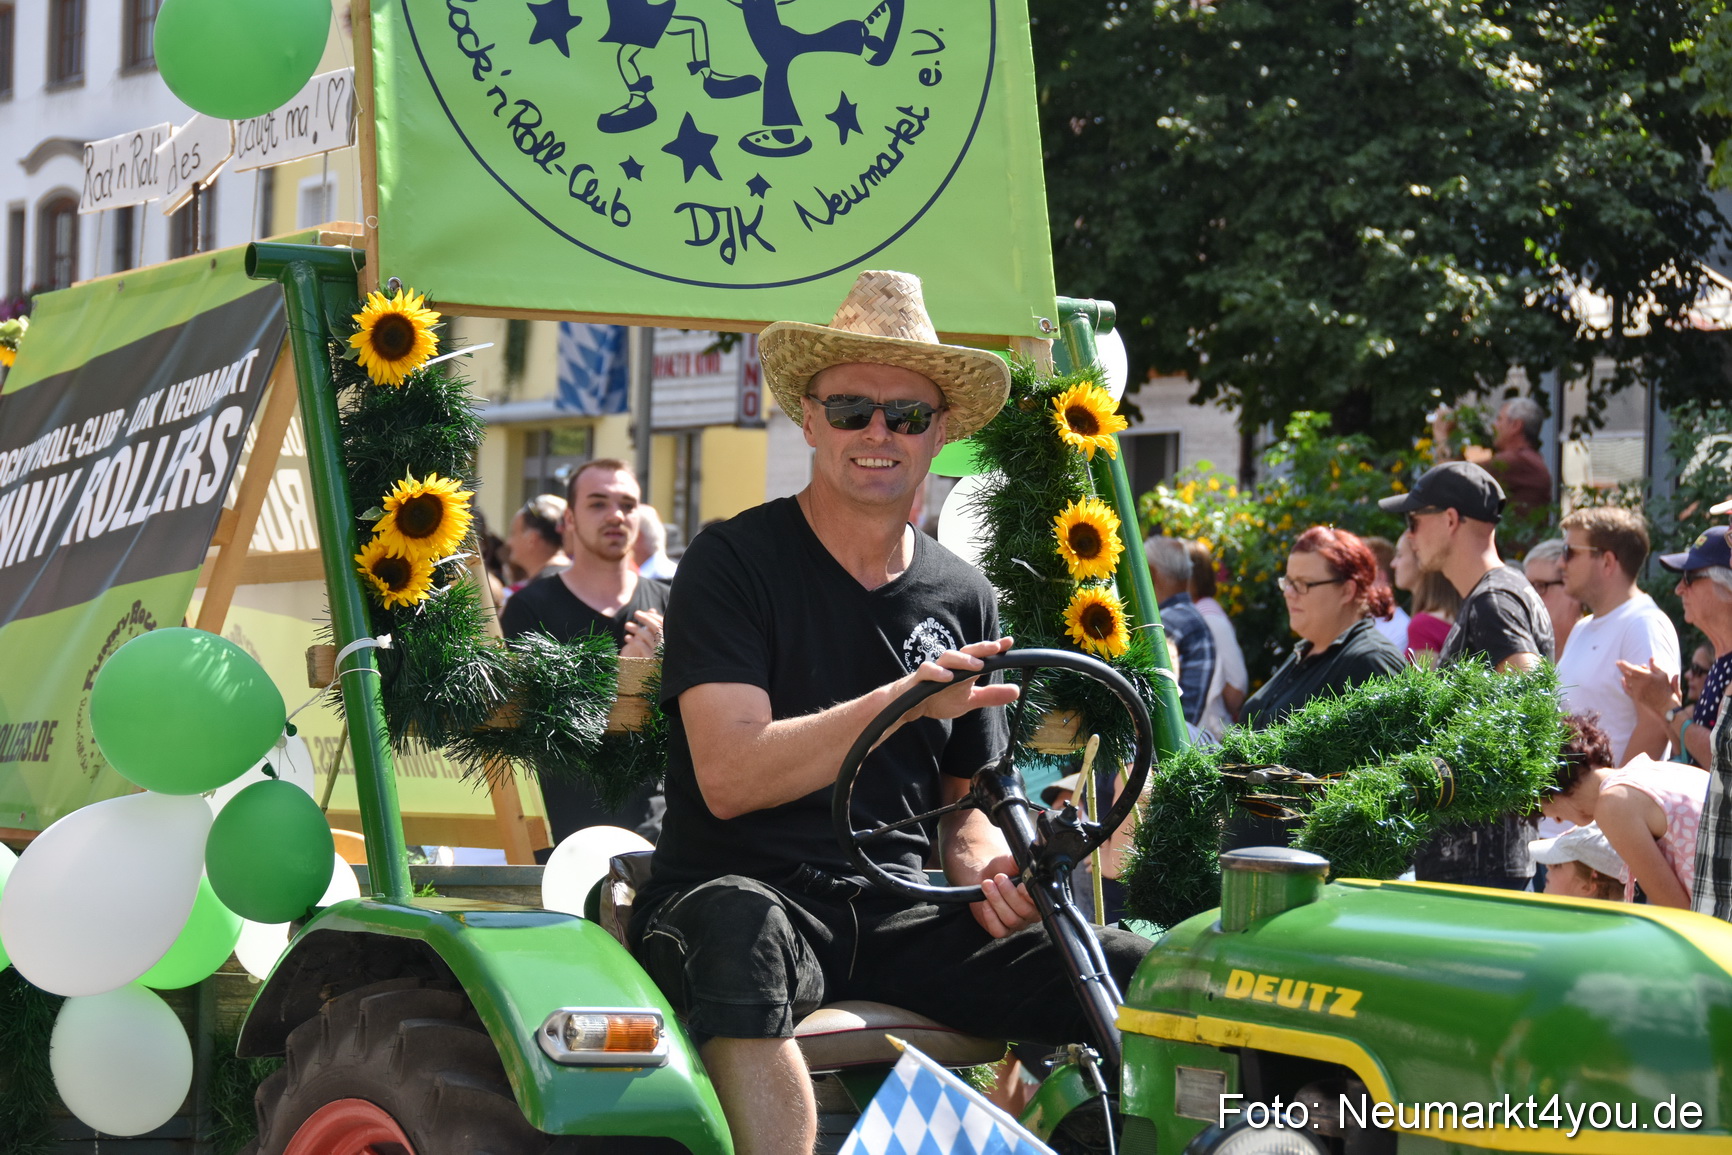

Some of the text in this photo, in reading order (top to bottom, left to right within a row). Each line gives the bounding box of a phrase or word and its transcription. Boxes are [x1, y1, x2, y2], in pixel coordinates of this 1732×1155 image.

[167, 141, 201, 195] des
[446, 0, 512, 118] ock'n
[507, 99, 631, 228] Roll-Club
[674, 202, 776, 266] DJK
[793, 105, 930, 232] Neumarkt
[158, 348, 260, 426] NEUMARKT
[0, 468, 83, 570] NNY
[60, 405, 243, 547] ROLLERS
[1224, 969, 1363, 1019] DEUTZ
